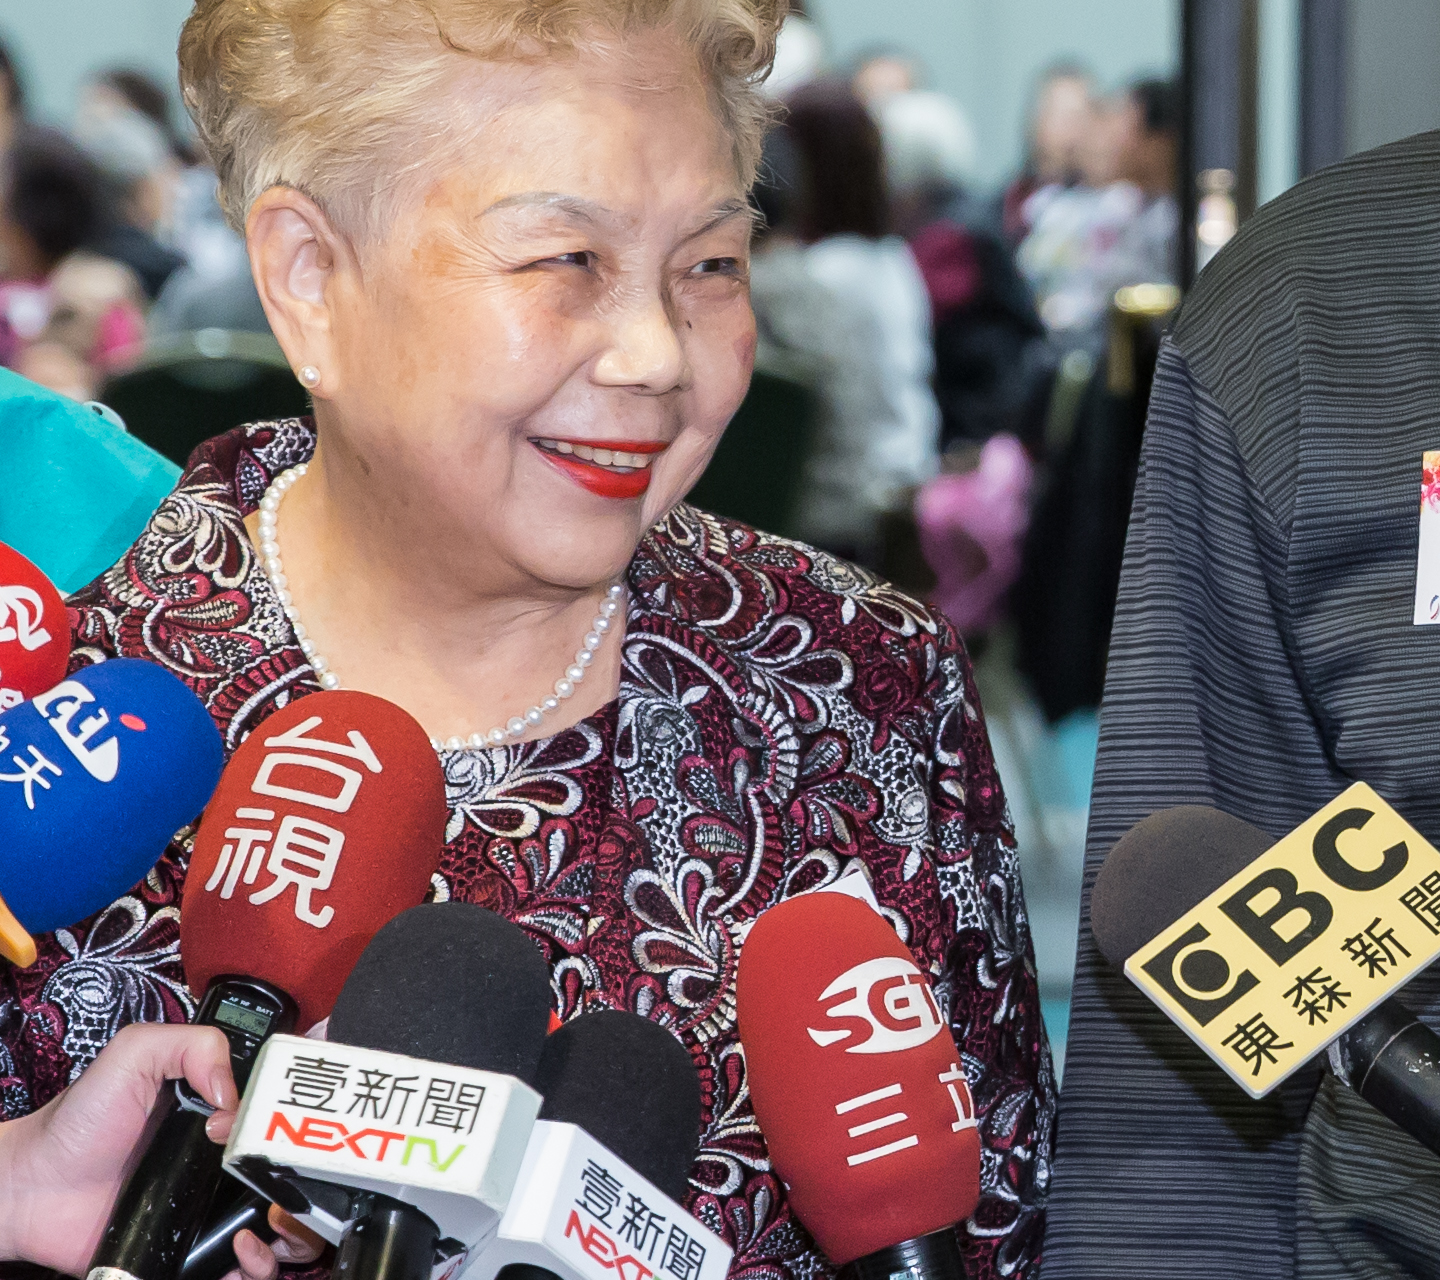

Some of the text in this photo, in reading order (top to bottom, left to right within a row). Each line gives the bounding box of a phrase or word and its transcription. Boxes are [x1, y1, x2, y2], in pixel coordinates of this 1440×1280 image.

[205, 716, 384, 929] 台視
[256, 1006, 274, 1016] BATT
[276, 1056, 488, 1135] 壹新聞
